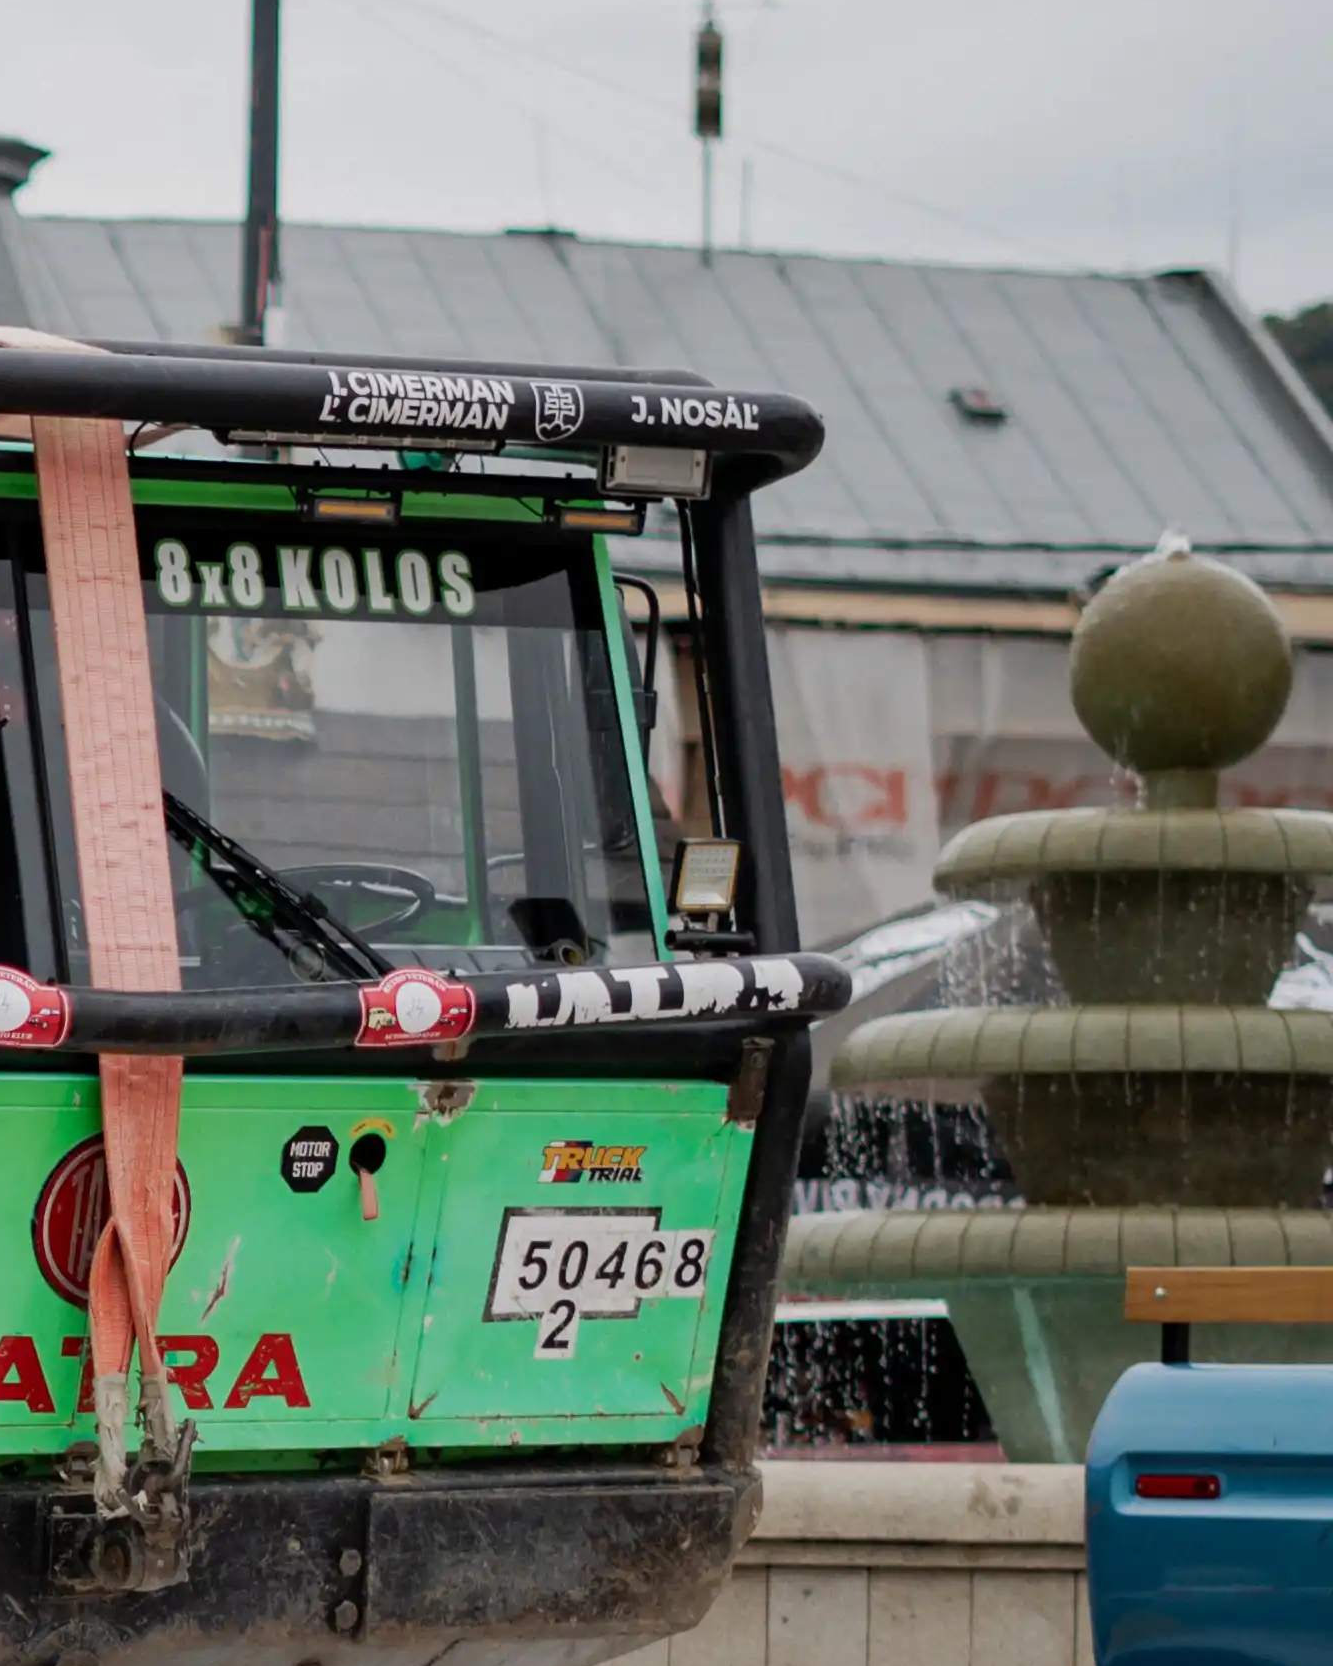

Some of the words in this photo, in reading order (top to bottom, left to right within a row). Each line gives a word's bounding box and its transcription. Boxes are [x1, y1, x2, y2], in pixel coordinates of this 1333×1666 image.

[347, 371, 516, 404] CIMERMAN
[348, 398, 510, 430] CIMERMAN
[632, 396, 655, 425] J.
[155, 538, 265, 611] 8x8
[277, 545, 476, 617] KOLOS
[290, 1141, 331, 1158] MOTOR
[542, 1145, 647, 1170] TRUCK
[292, 1162, 324, 1178] STOP
[587, 1167, 644, 1182] TRIAL
[518, 1238, 705, 1290] 50468
[540, 1299, 577, 1349] 2
